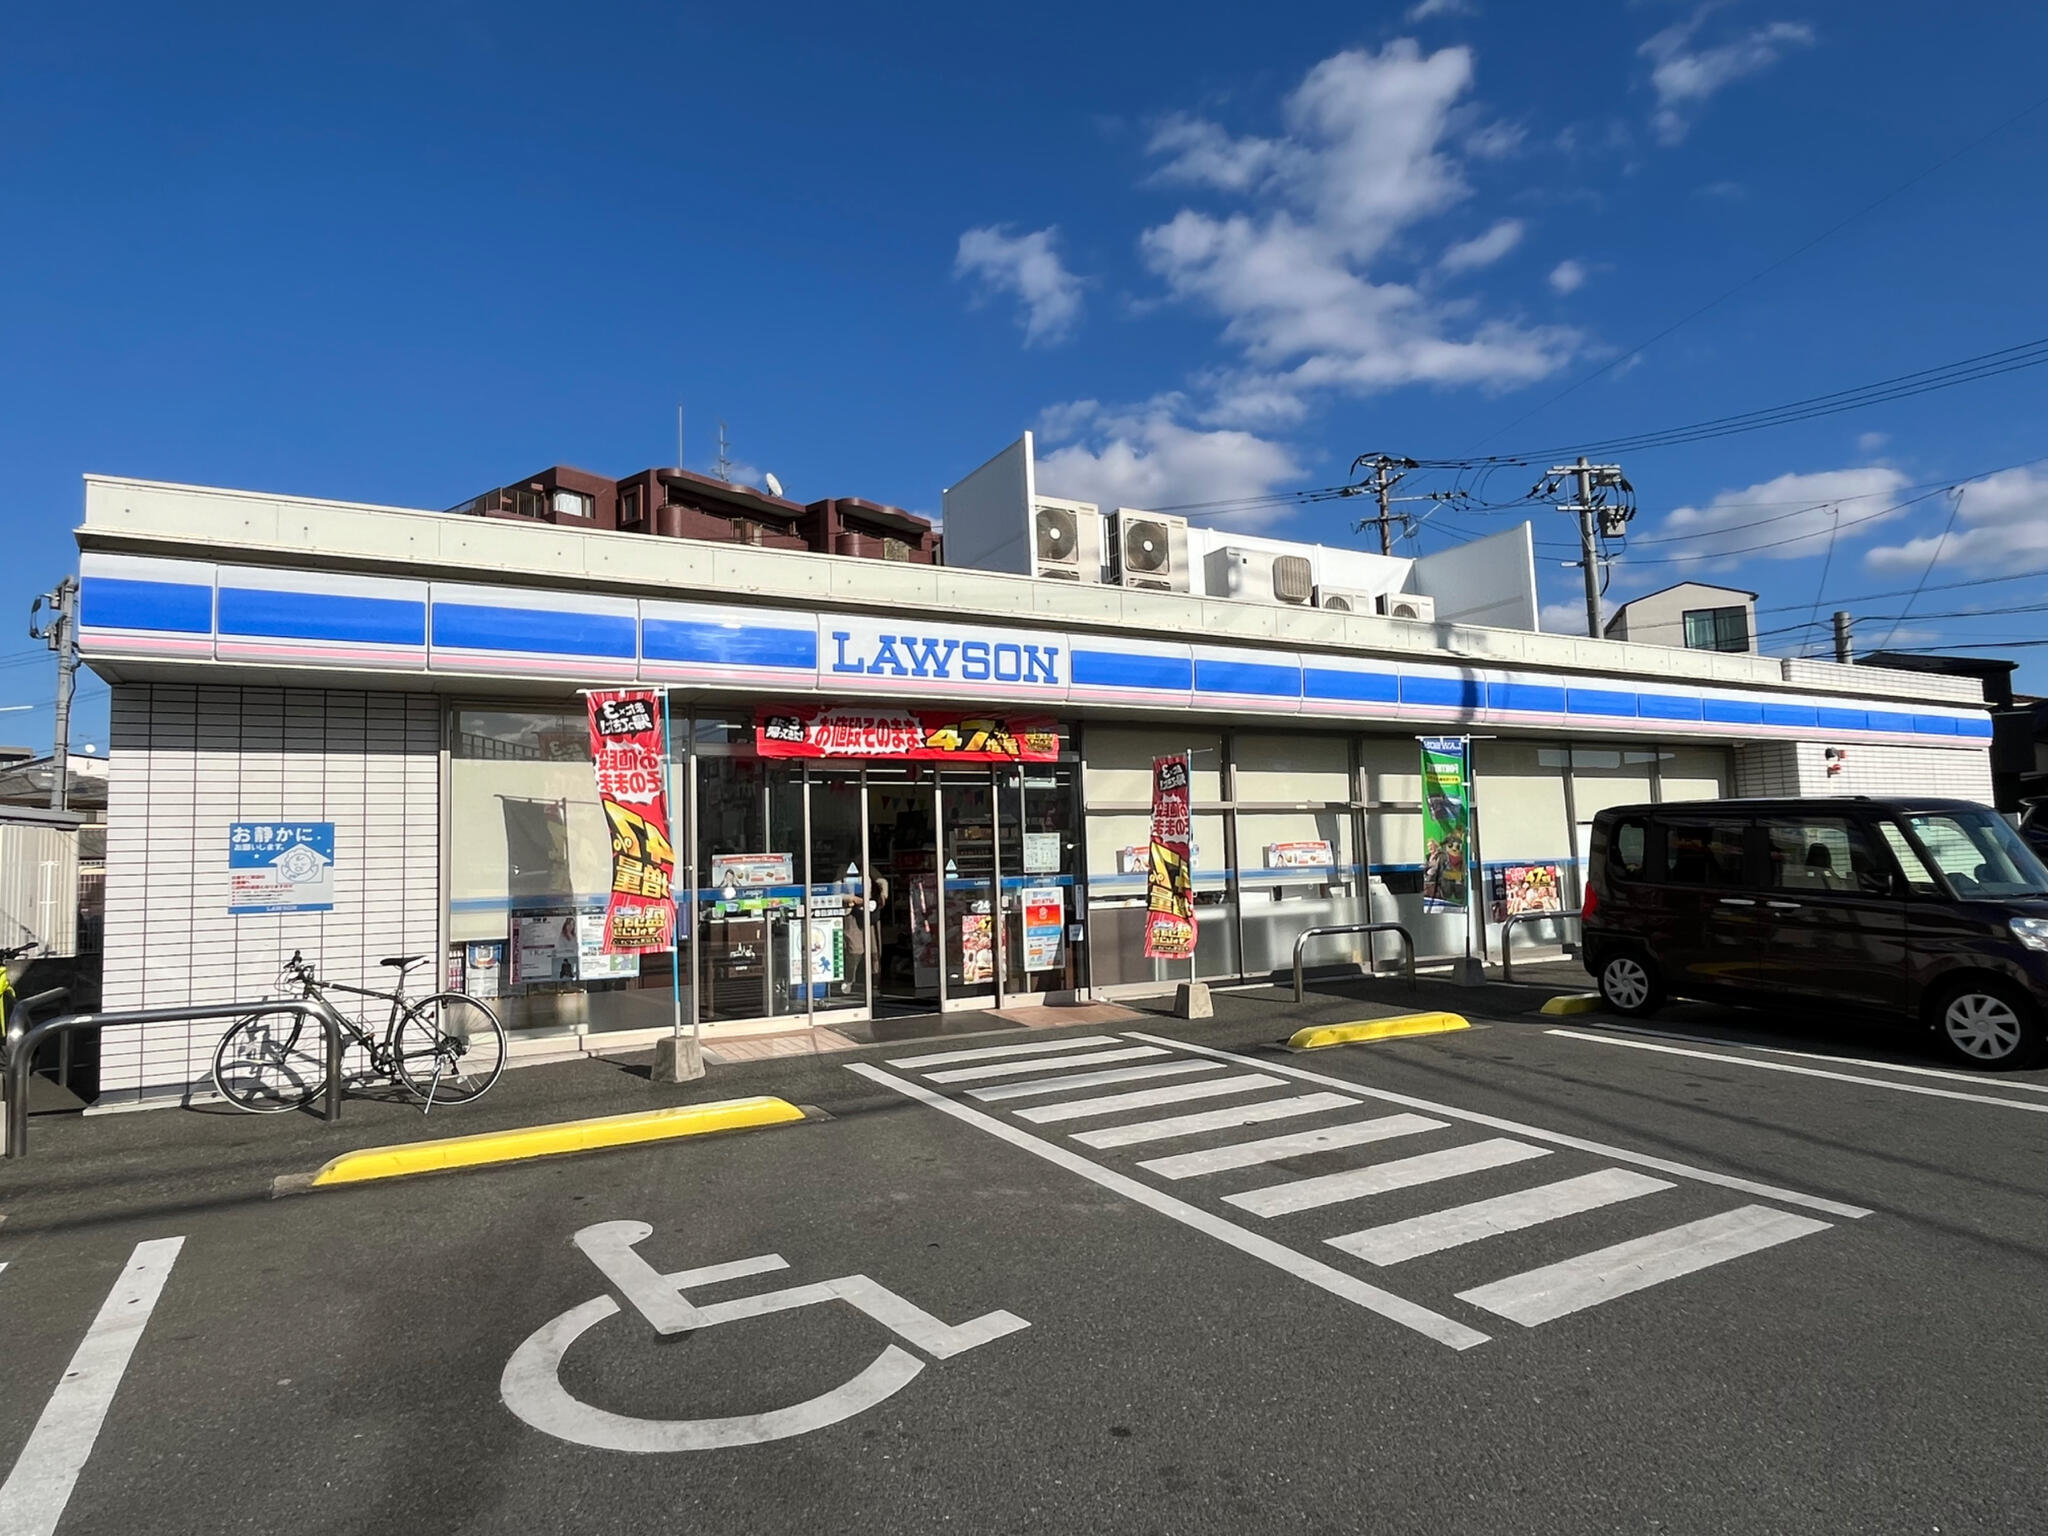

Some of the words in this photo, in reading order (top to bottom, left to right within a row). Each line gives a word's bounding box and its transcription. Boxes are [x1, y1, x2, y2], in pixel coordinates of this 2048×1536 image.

[832, 631, 1060, 685] LAWSON
[814, 715, 920, 749] お値段そのまま
[232, 826, 313, 843] お静かに
